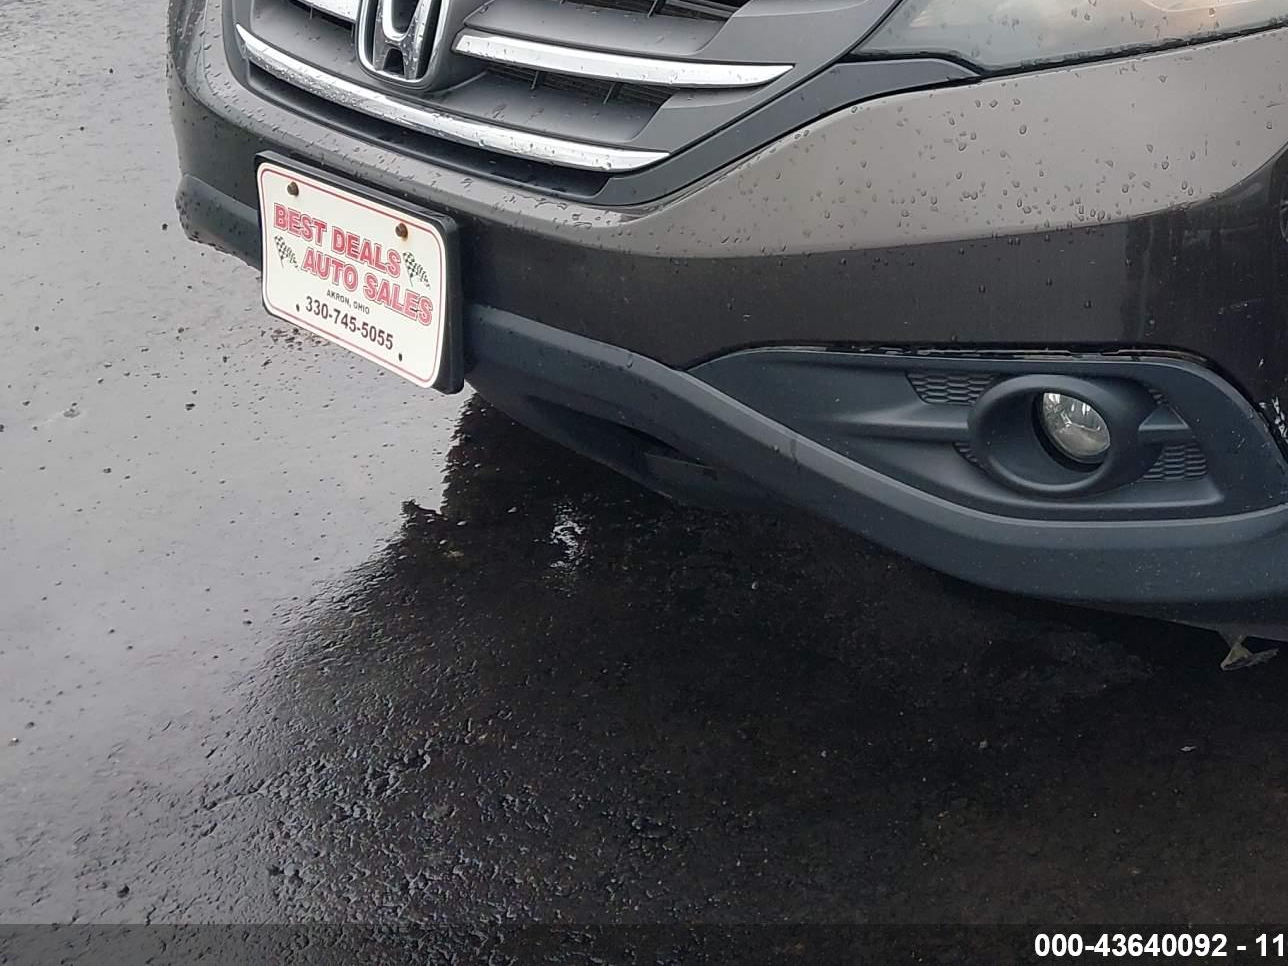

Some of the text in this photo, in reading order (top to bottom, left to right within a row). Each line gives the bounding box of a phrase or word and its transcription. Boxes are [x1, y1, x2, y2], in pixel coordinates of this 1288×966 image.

[272, 201, 402, 279] BEST DEALS
[300, 246, 434, 326] AUTO SALES
[353, 299, 371, 315] OHIO
[305, 295, 395, 351] 330-745-5055
